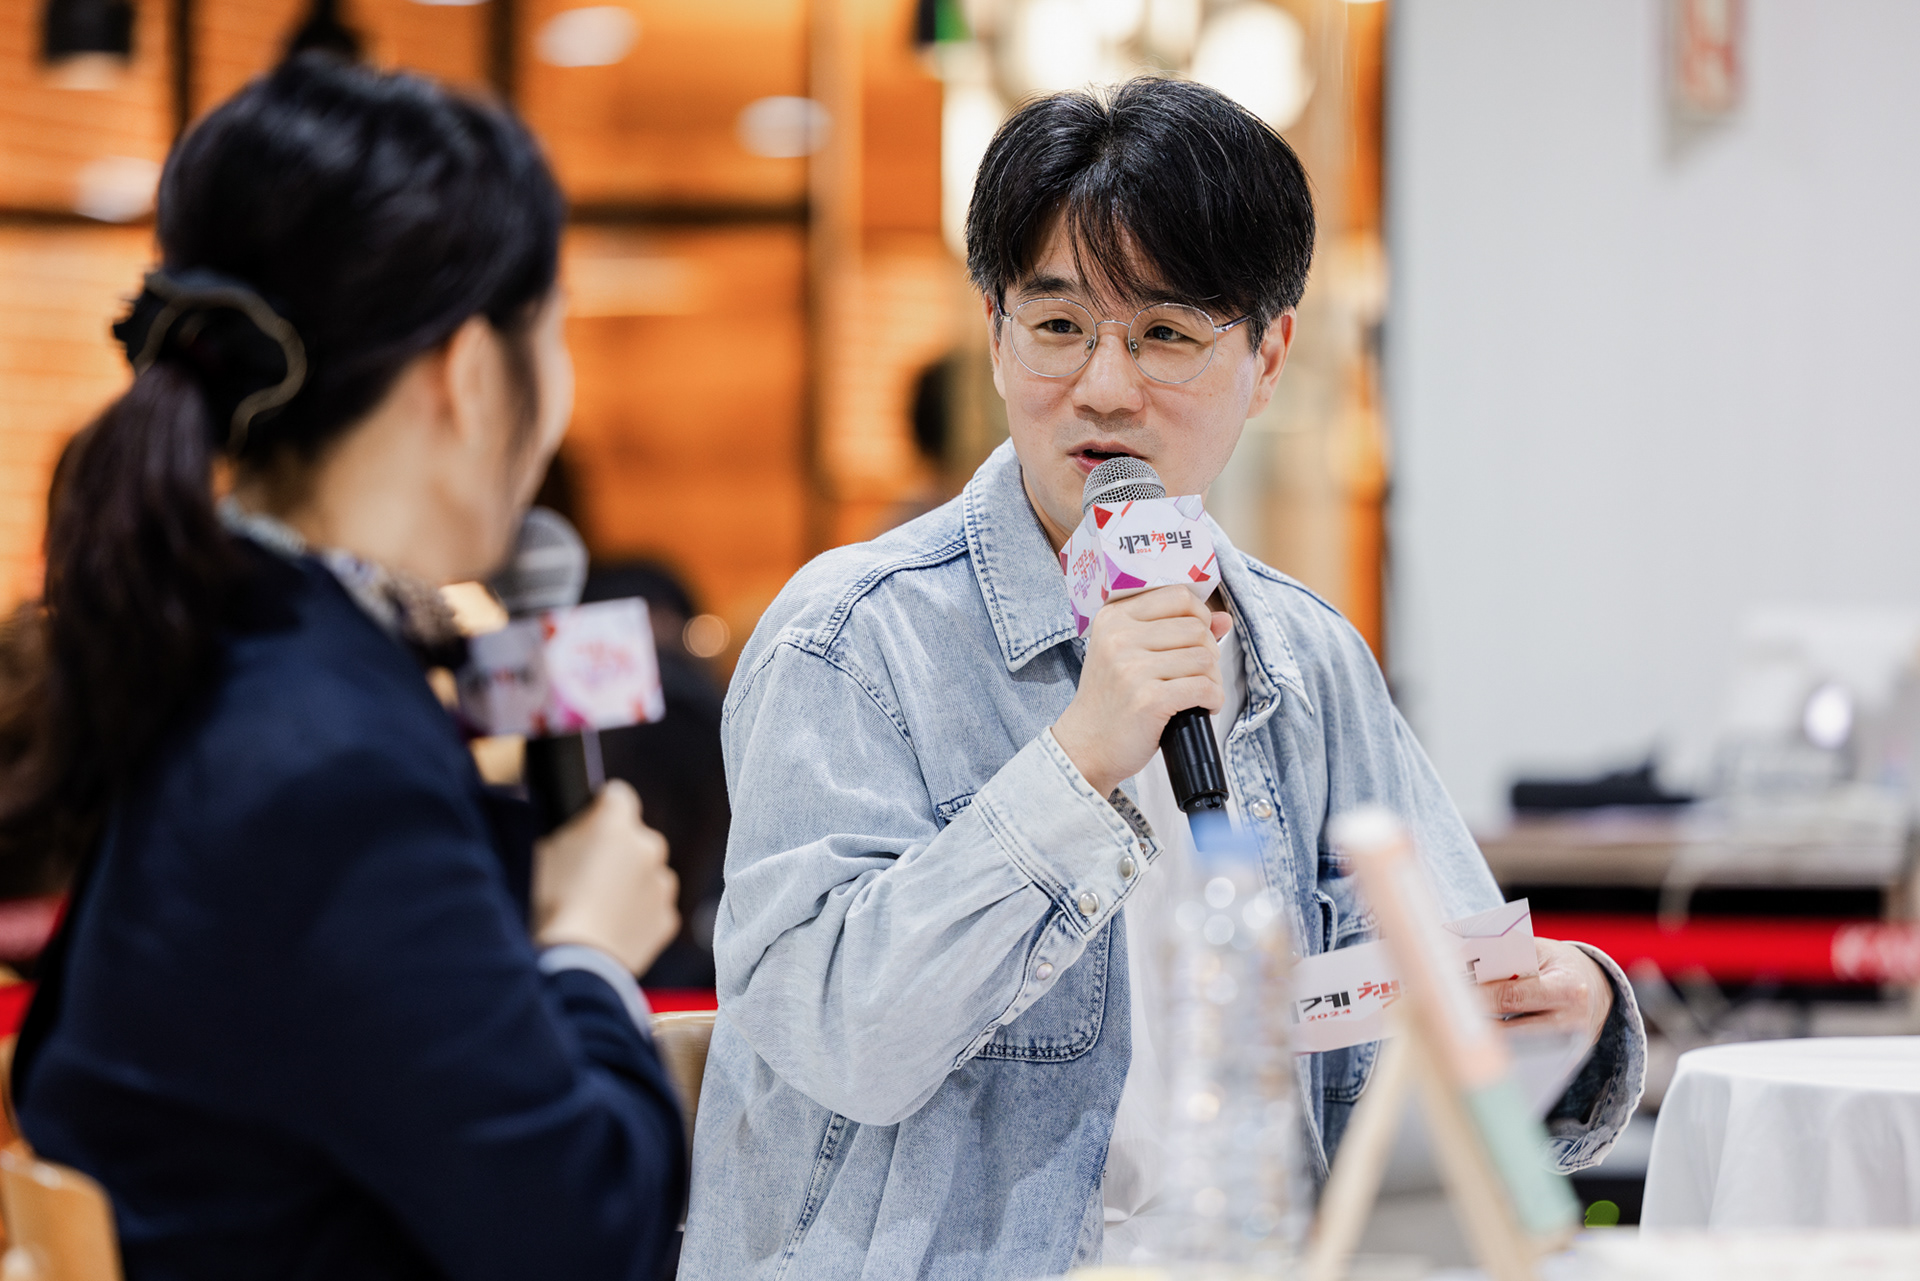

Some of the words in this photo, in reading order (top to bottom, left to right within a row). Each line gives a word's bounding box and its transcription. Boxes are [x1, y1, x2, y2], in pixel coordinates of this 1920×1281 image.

[1119, 534, 1150, 554] 세계
[1178, 530, 1193, 549] 날
[1305, 1008, 1352, 1022] 2024
